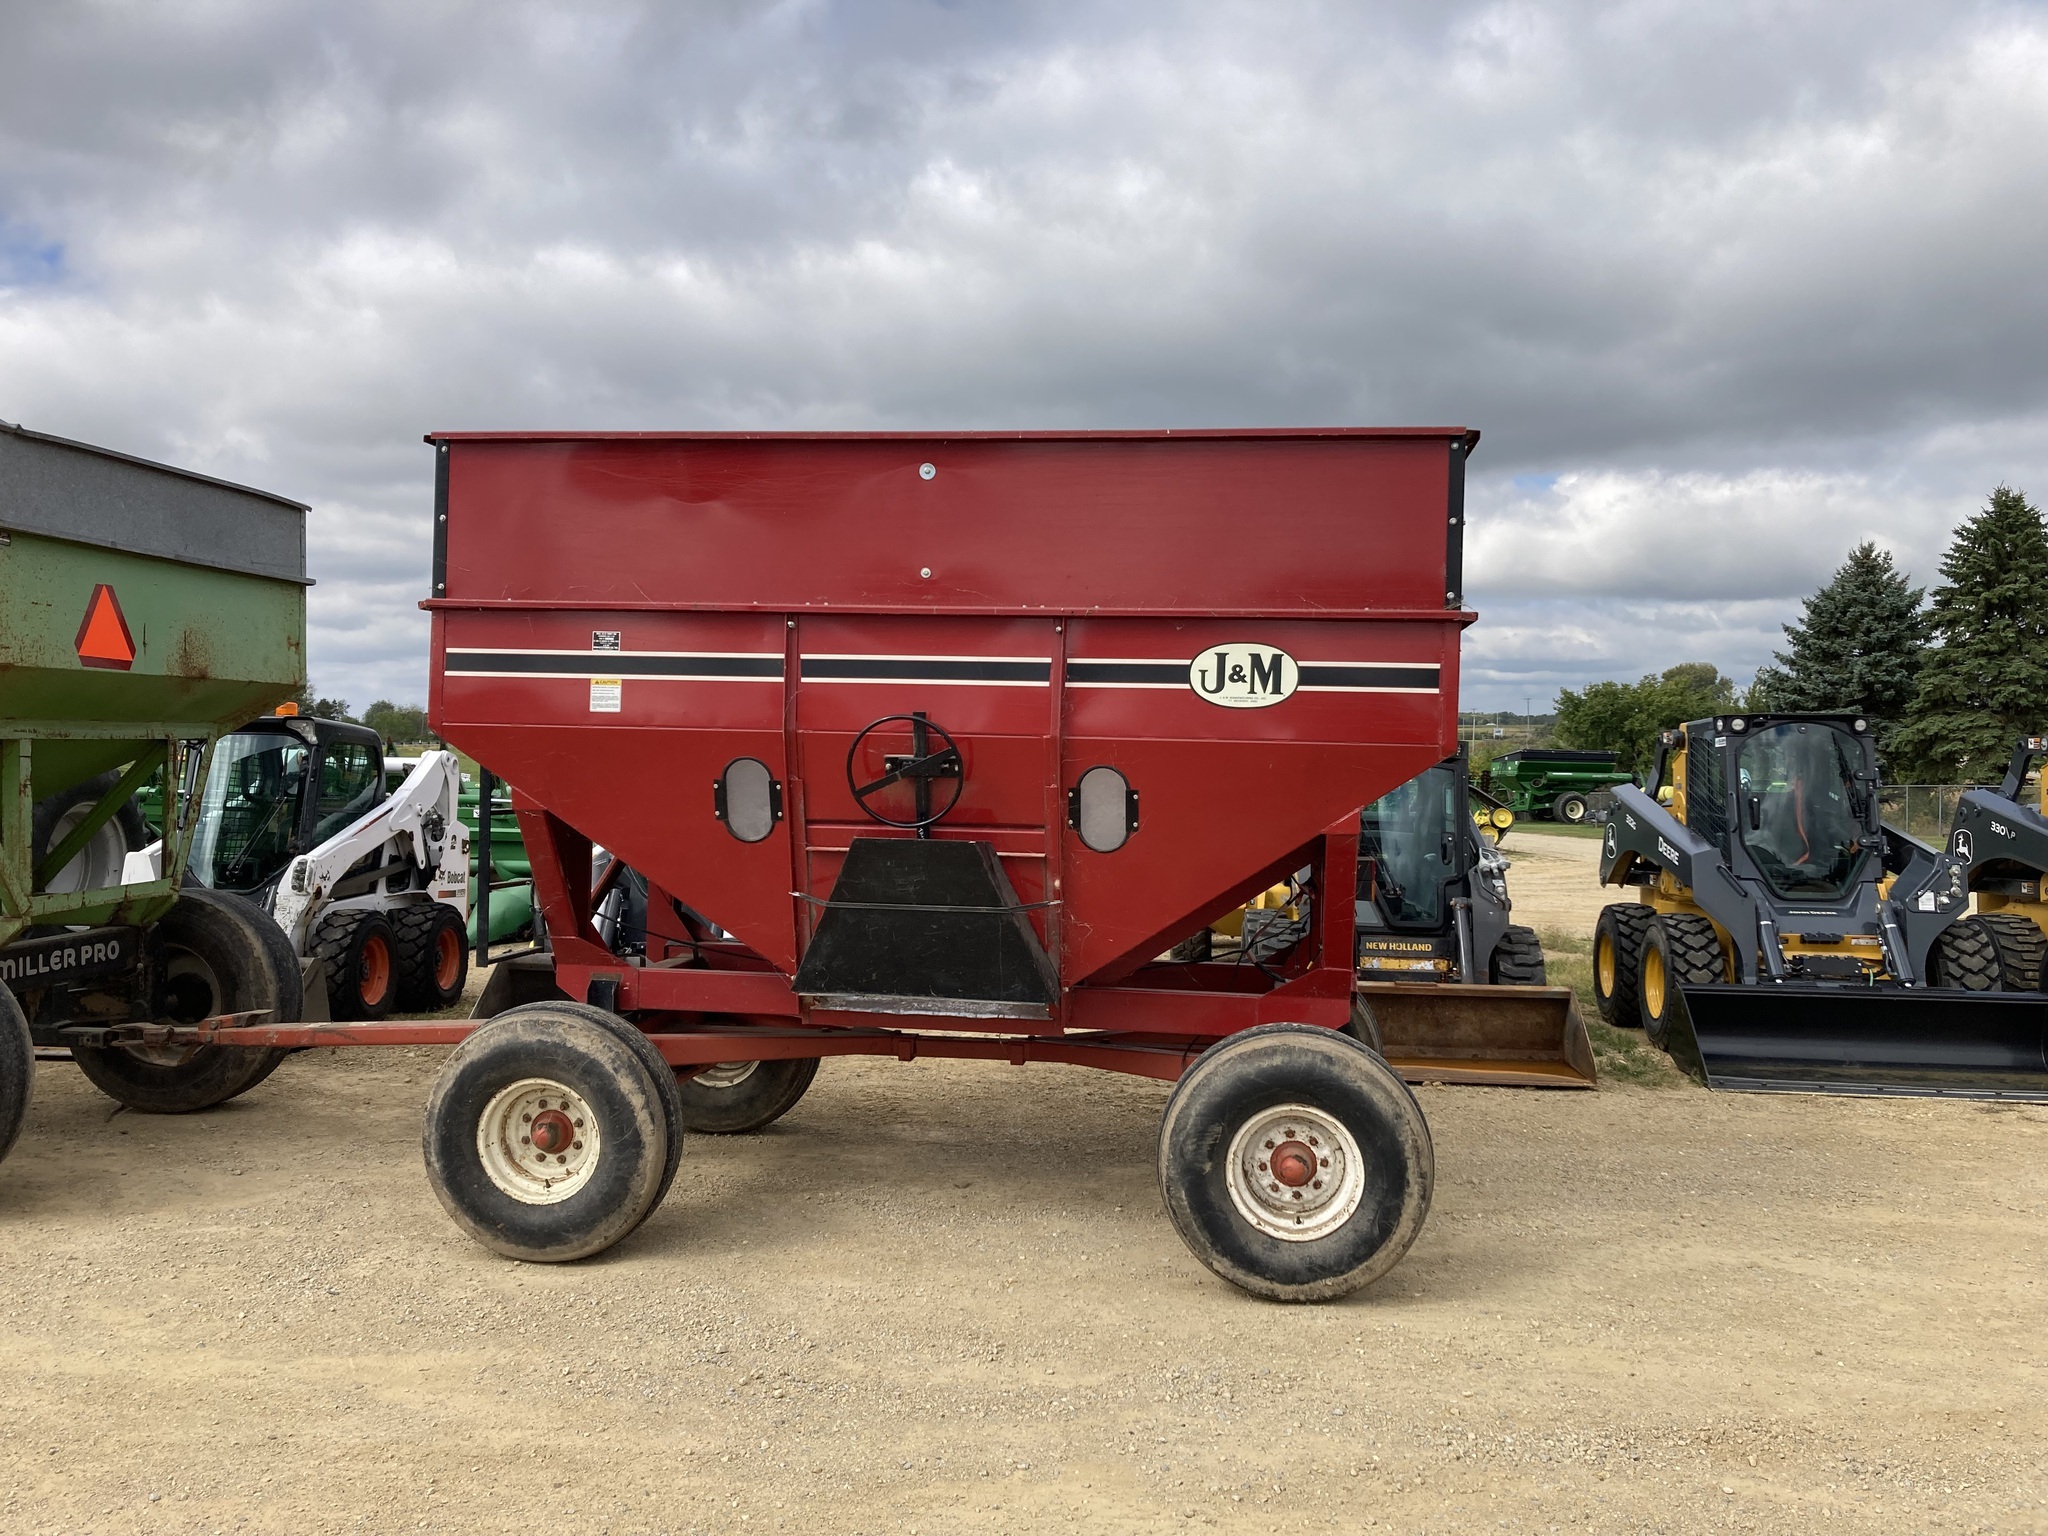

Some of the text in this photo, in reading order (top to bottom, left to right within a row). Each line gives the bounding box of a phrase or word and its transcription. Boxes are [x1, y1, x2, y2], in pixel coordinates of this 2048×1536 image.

[1198, 652, 1285, 695] J&M
[1658, 835, 1680, 866] DEERE
[447, 870, 466, 884] Bobcat
[0, 940, 120, 981] MILLER PRO
[1365, 941, 1432, 952] NEW HOLLAND
